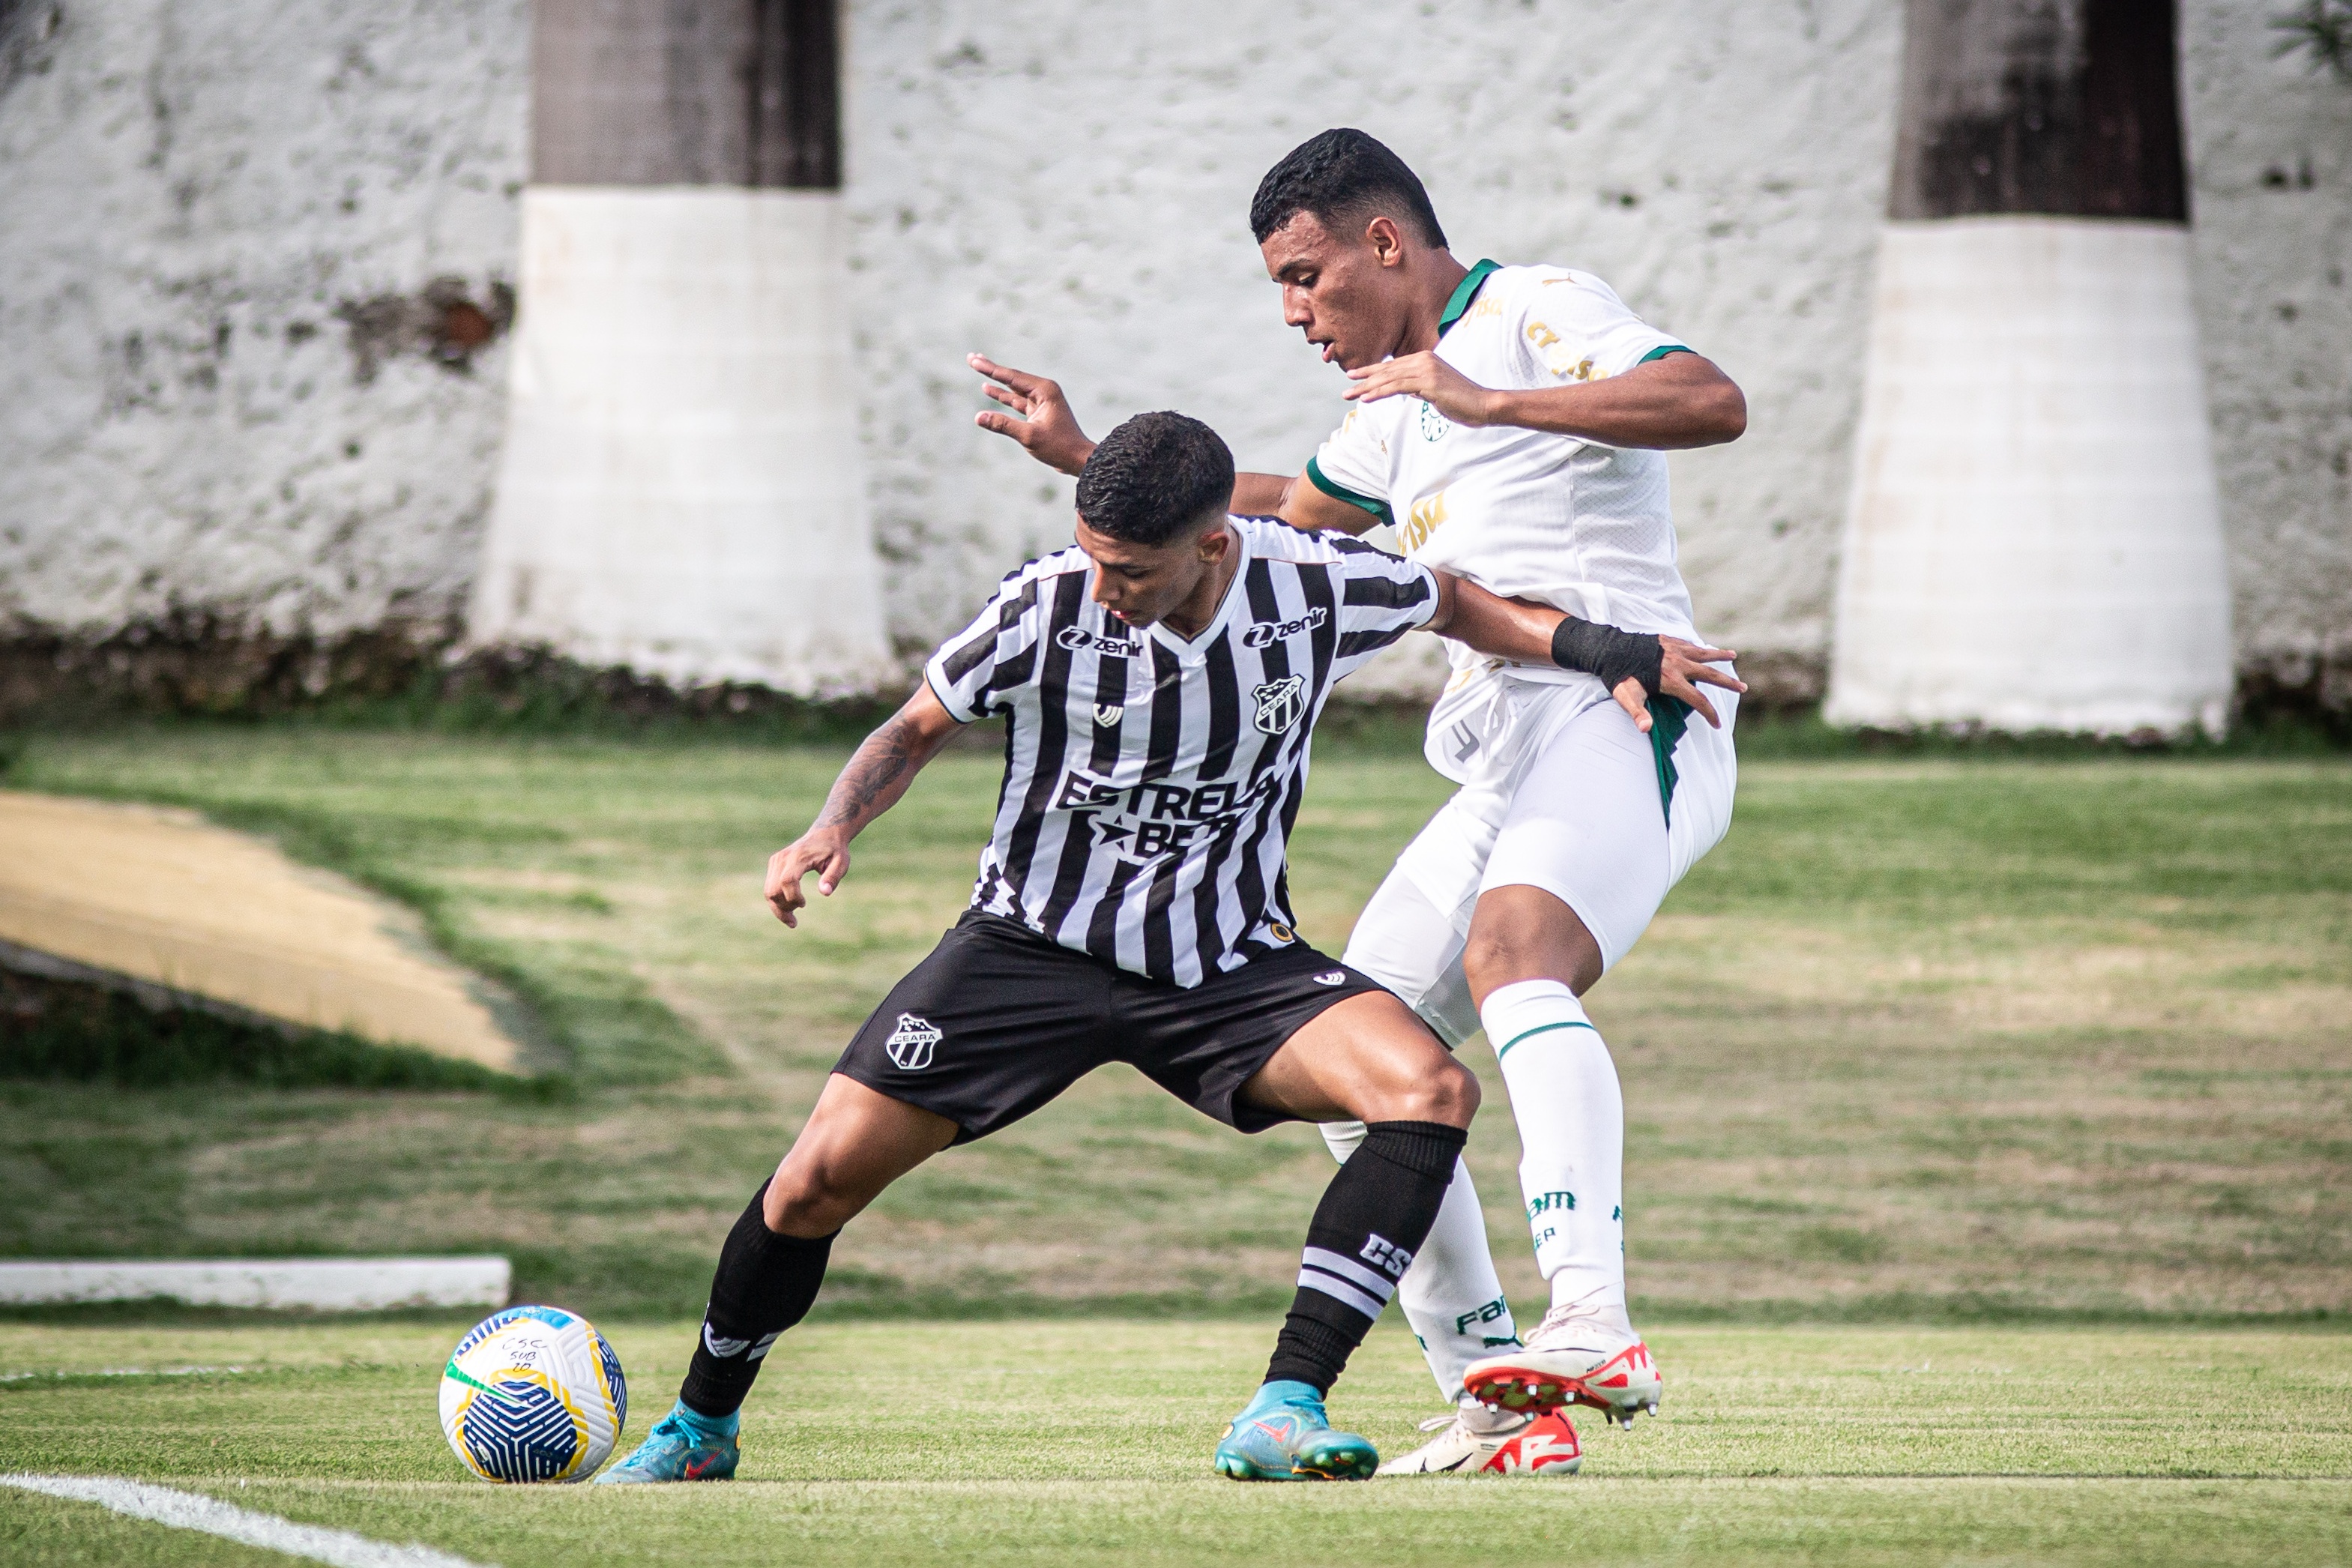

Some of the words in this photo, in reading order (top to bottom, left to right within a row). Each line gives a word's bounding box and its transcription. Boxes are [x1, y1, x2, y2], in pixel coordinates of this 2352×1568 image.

[1277, 608, 1327, 638] zenir
[1094, 637, 1144, 657] zenir
[1056, 771, 1282, 821] ESTRELA
[502, 1337, 548, 1350] CSC
[509, 1351, 537, 1361] SUB
